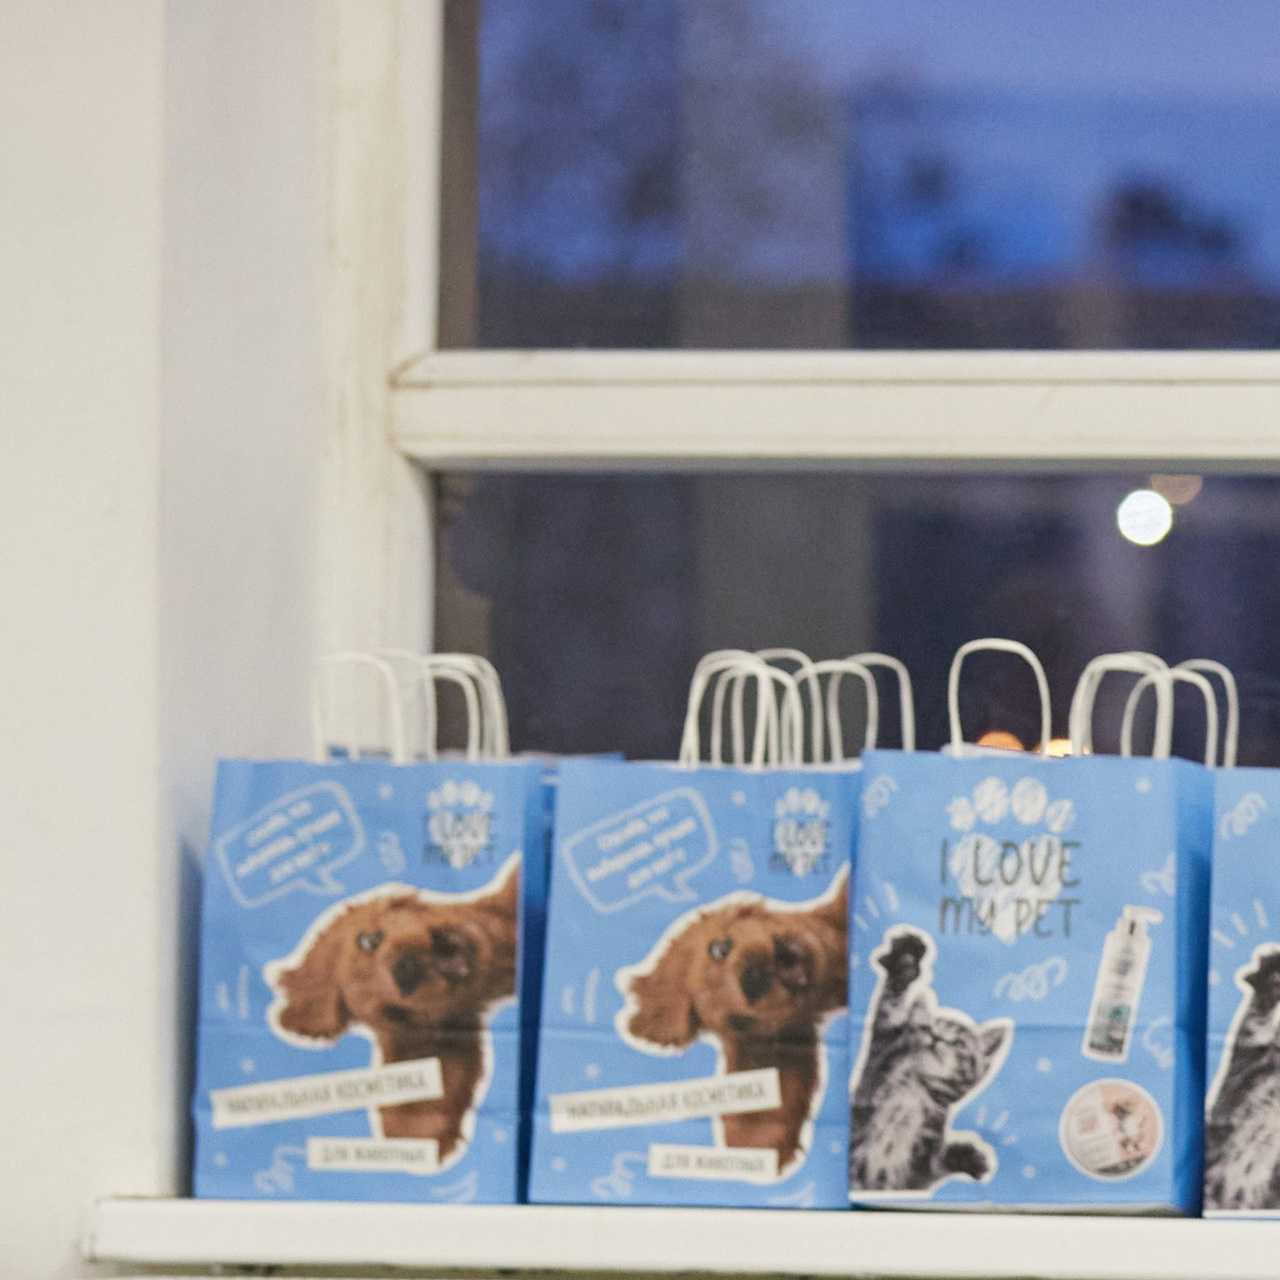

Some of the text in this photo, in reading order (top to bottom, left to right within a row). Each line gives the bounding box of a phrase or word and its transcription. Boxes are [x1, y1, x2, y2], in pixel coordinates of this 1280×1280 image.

[940, 838, 1082, 887] I LOVE
[1015, 896, 1081, 938] PET
